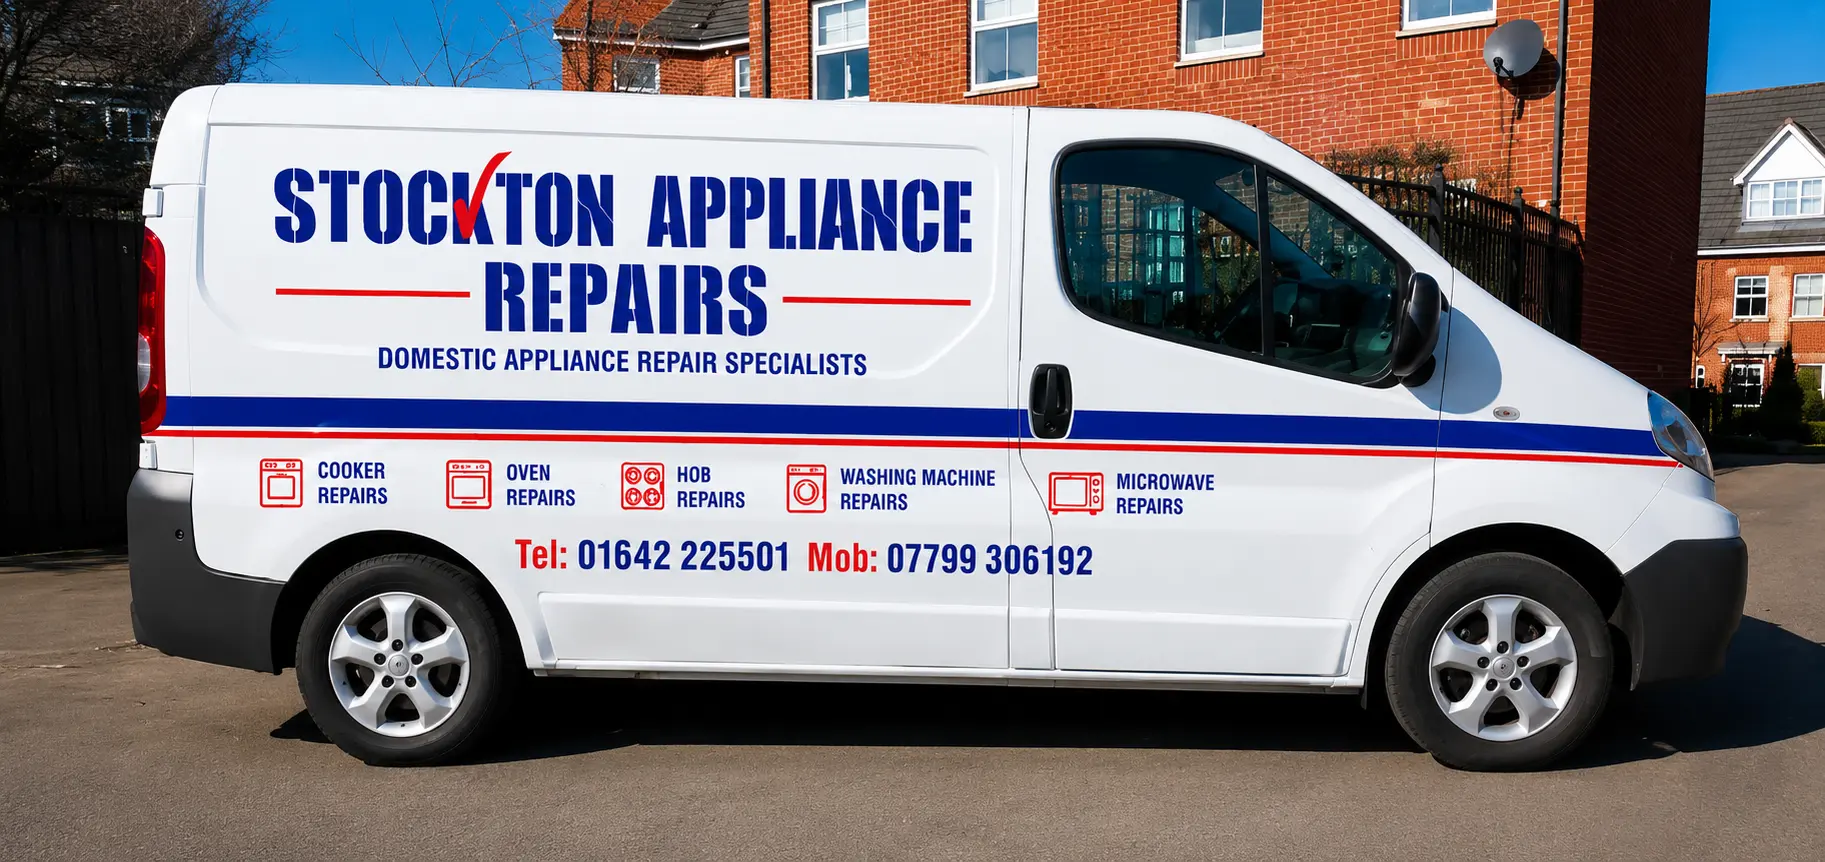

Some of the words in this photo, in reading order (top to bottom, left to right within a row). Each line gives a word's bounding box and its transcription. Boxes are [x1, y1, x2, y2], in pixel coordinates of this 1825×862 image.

[274, 168, 613, 246] STOCKTON
[648, 176, 972, 252] APPLIANCE
[485, 262, 767, 336] REPAIRS
[379, 347, 496, 370] DOMESTIC
[504, 349, 628, 372] APPLIANCE
[638, 351, 716, 373] REPAIR
[726, 352, 866, 376] SPECIALISTS
[319, 462, 384, 478] COOKER
[507, 464, 550, 480] OVEN
[678, 466, 710, 482] HOB
[841, 469, 916, 485] WASHING
[923, 470, 995, 486] MACHINE
[1117, 474, 1213, 490] MICROWAVE
[319, 487, 387, 504] REPAIRS
[507, 489, 575, 506] REPAIRS
[678, 492, 744, 508] REPAIRS
[841, 493, 907, 510] REPAIRS
[1117, 498, 1183, 514] REPAIRS
[515, 539, 566, 569] Tel:
[579, 540, 670, 570] 01642
[681, 541, 787, 571] 225501
[808, 542, 876, 572] Mob:
[888, 544, 976, 574] 07799
[986, 544, 1092, 575] 306192
